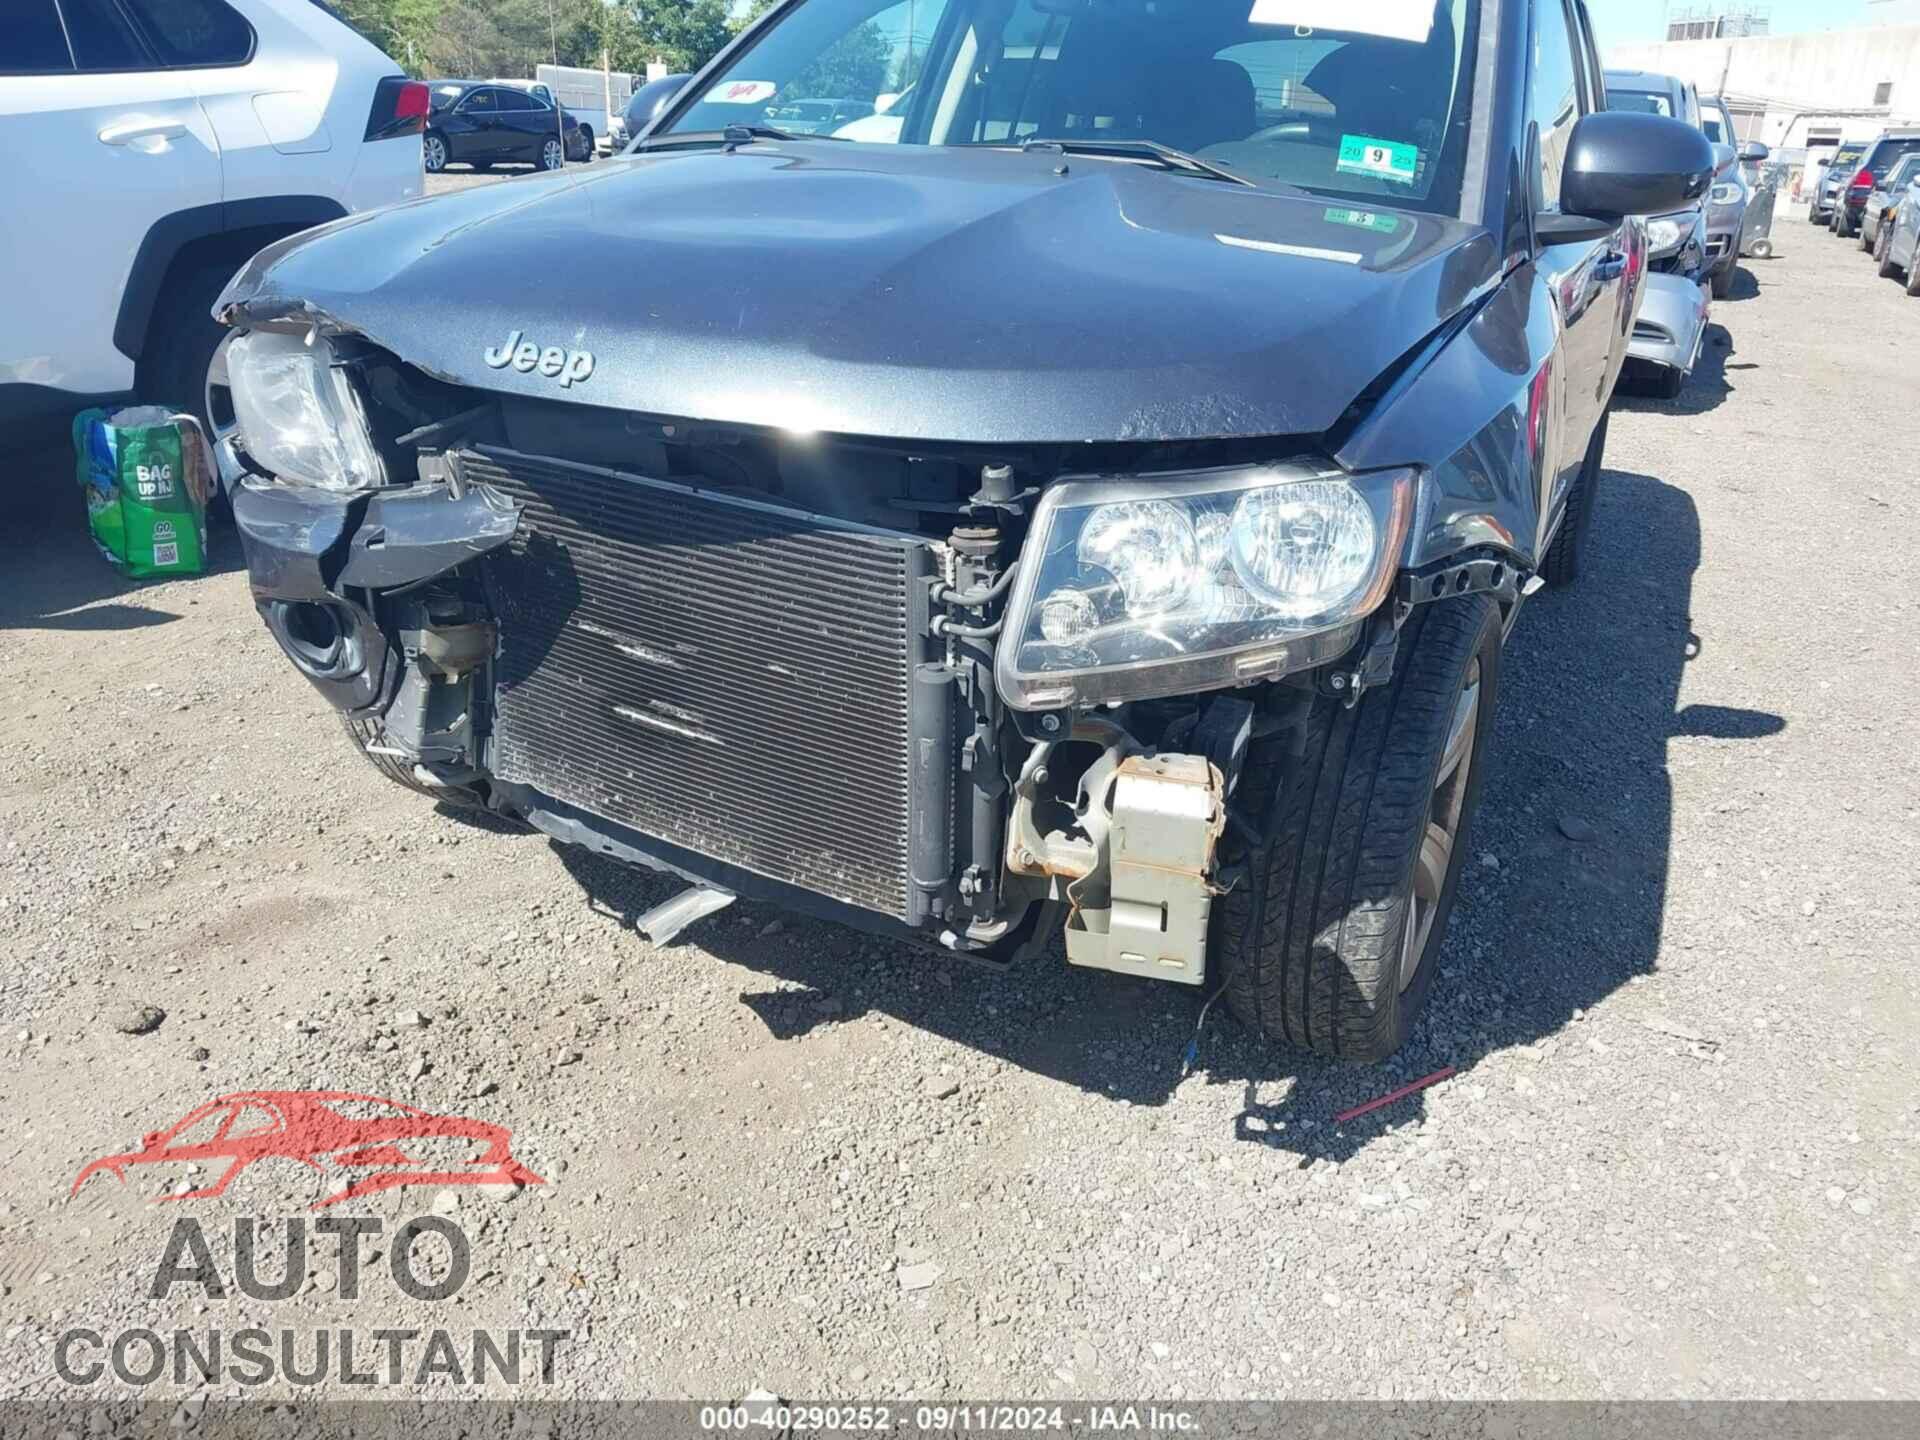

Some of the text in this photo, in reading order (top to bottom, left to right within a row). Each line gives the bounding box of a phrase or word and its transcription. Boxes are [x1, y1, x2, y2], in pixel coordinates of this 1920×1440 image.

[1373, 148, 1384, 163] 9
[484, 331, 596, 389] Jeep
[136, 464, 171, 481] BAG
[138, 482, 156, 496] UP
[156, 521, 170, 534] GO
